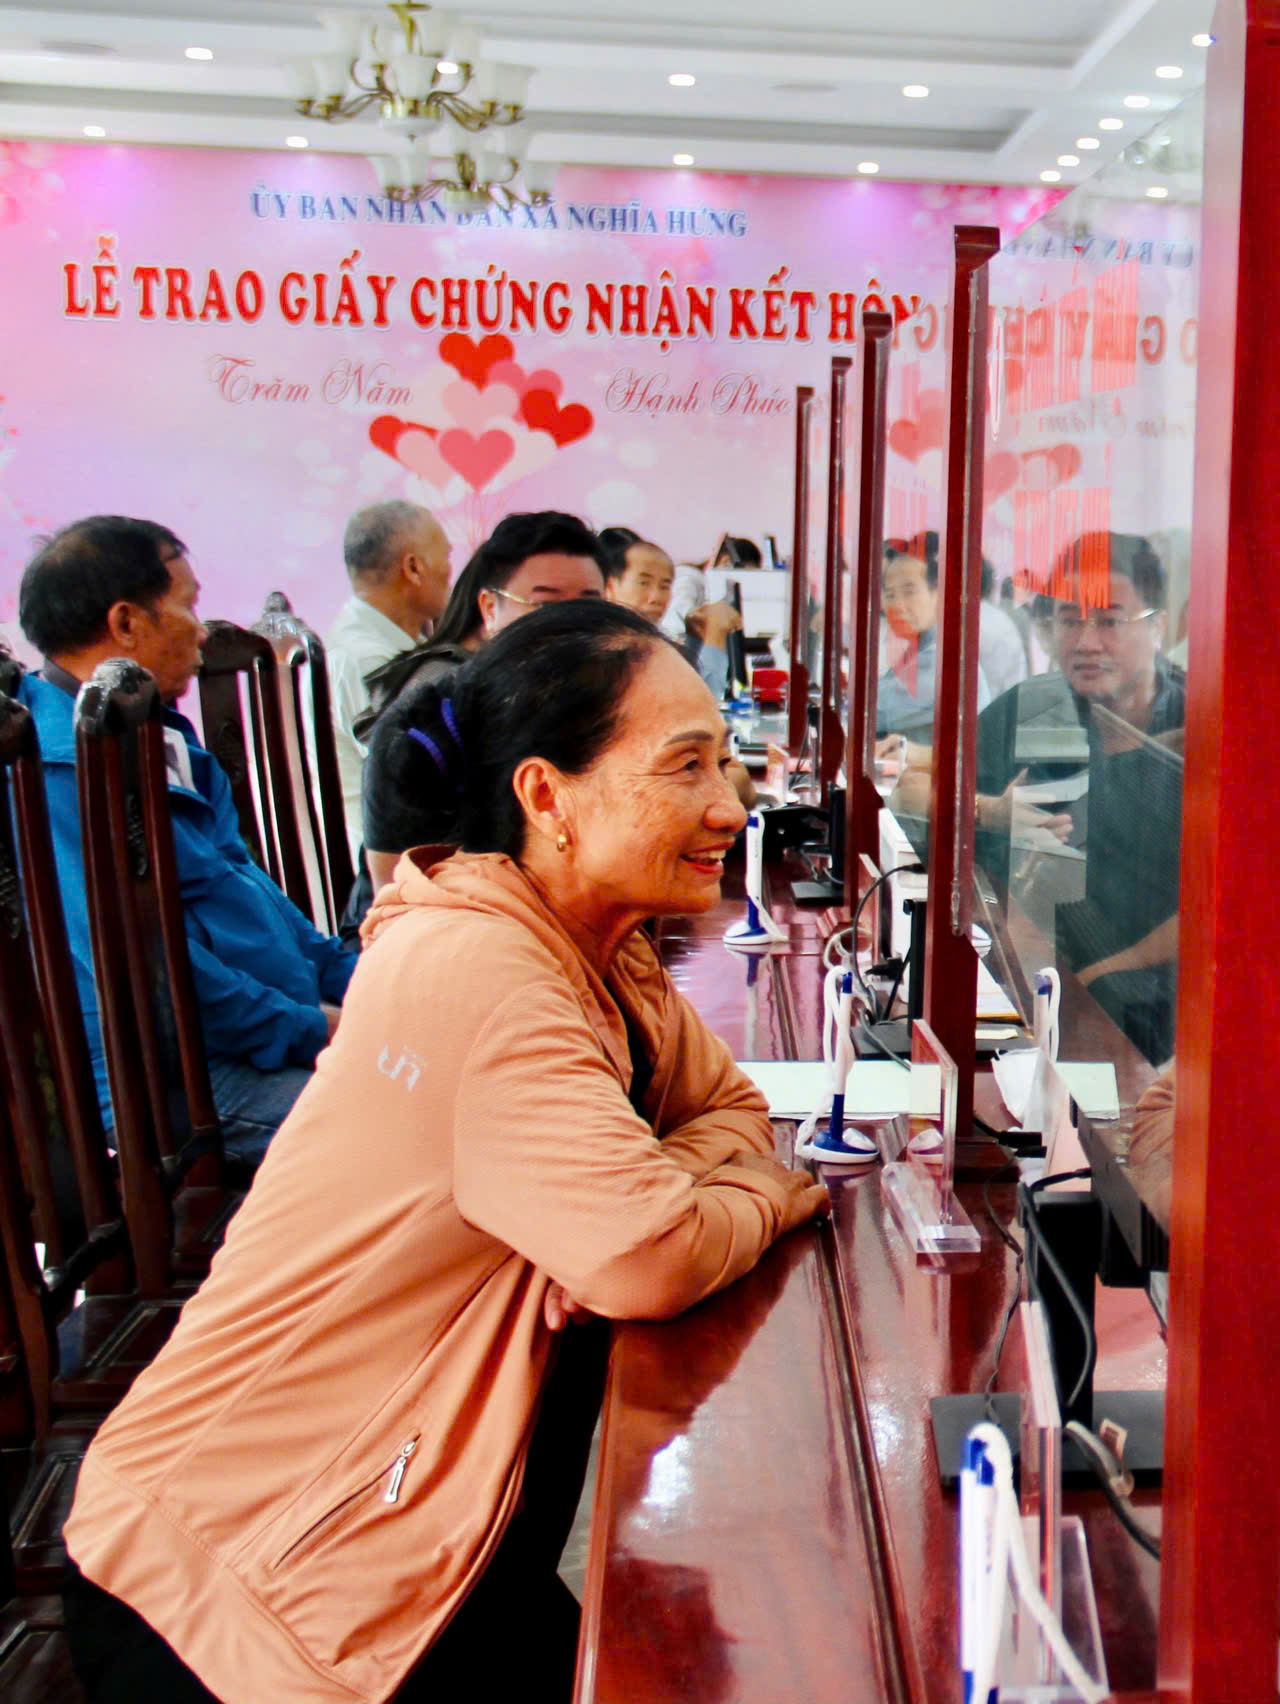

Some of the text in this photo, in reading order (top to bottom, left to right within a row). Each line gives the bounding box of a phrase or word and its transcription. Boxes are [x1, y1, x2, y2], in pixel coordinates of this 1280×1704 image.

[300, 195, 358, 221] BAN
[568, 199, 659, 234] NGHĨA
[63, 236, 120, 316] LỄ
[133, 266, 265, 323] TRAO
[279, 249, 397, 327] GIẤY
[410, 264, 573, 334] CHỨNG
[585, 270, 717, 351] NHẬN
[729, 266, 817, 341] KẾT
[208, 354, 793, 419] Trăm Năm Hạnh Phúc
